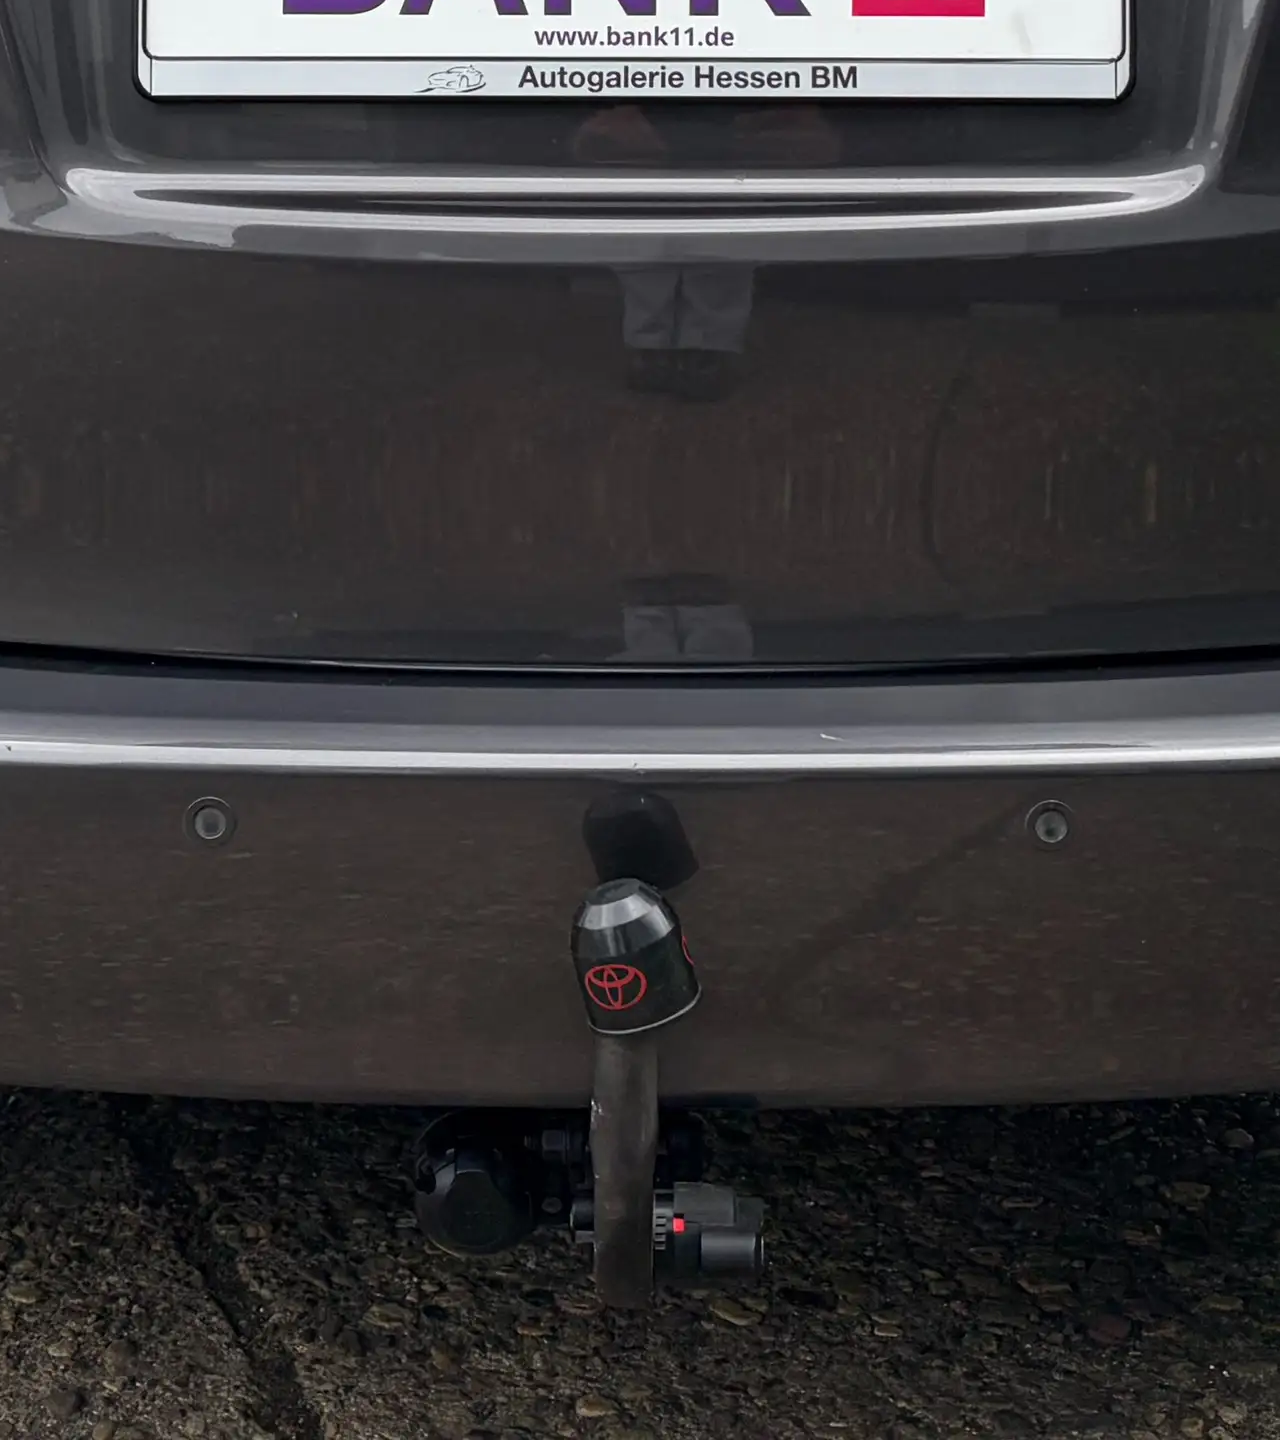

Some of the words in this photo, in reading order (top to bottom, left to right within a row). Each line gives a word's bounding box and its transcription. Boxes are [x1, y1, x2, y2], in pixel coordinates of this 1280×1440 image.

[534, 25, 735, 47] www.bank11.de
[518, 64, 684, 92] Autogalerie
[693, 65, 801, 89] Hessen
[810, 65, 858, 89] BM
